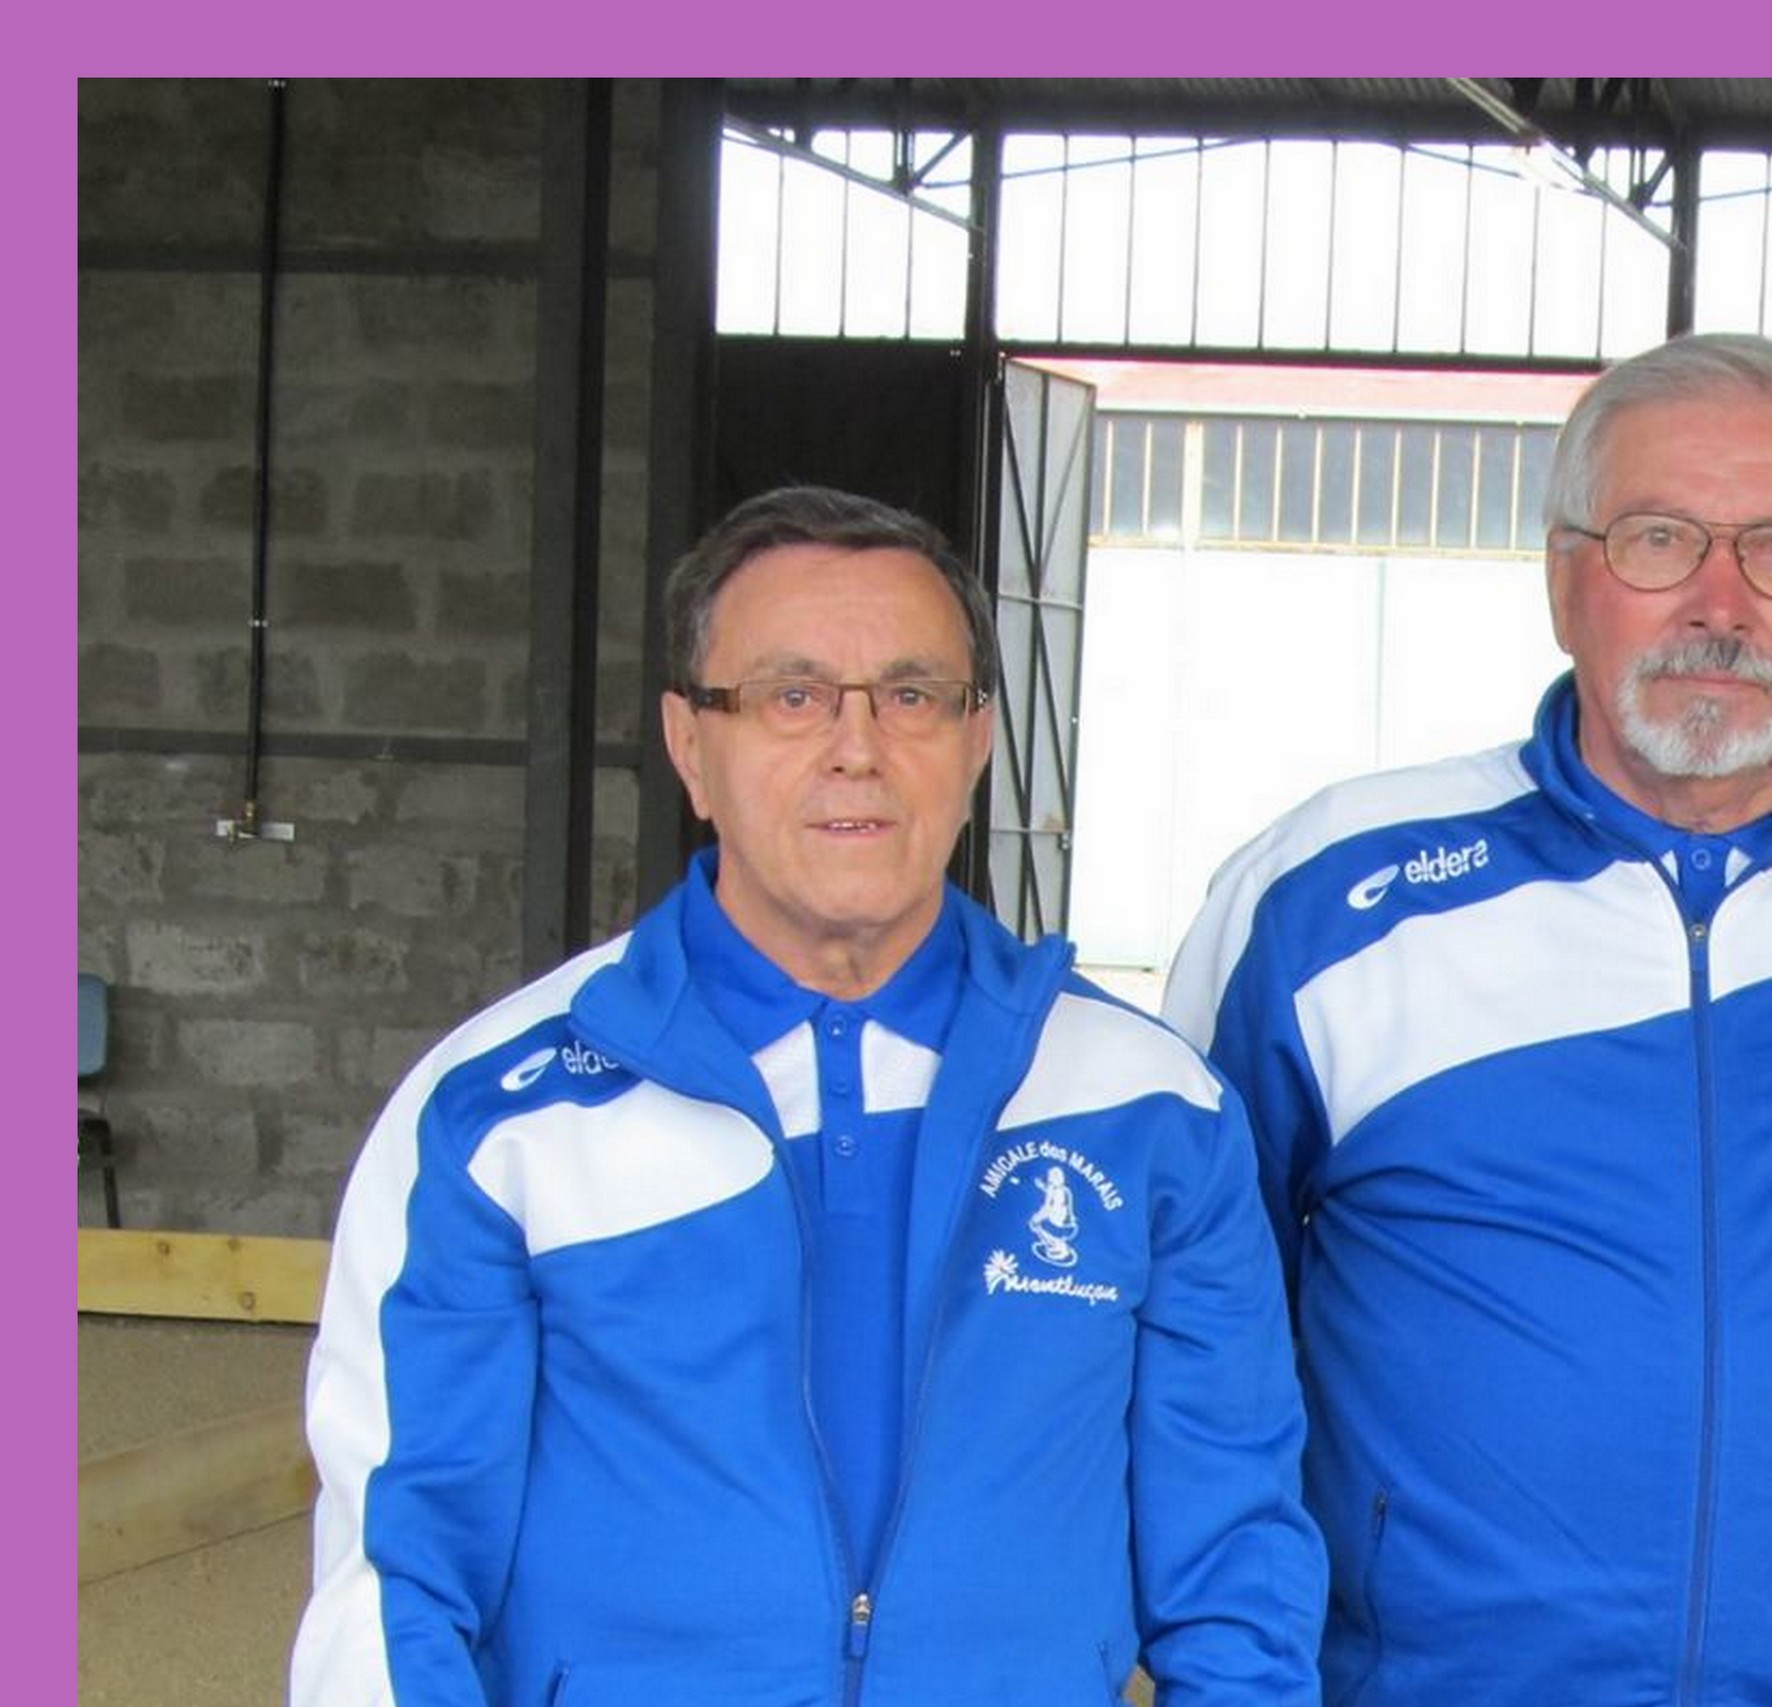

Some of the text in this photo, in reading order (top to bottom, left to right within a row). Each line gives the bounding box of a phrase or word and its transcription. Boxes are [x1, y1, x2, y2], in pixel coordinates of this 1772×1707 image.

[1404, 838, 1489, 884] eldera
[979, 1141, 1124, 1211] AMICALE des MARAIS
[988, 1273, 1119, 1307] Montluçon
